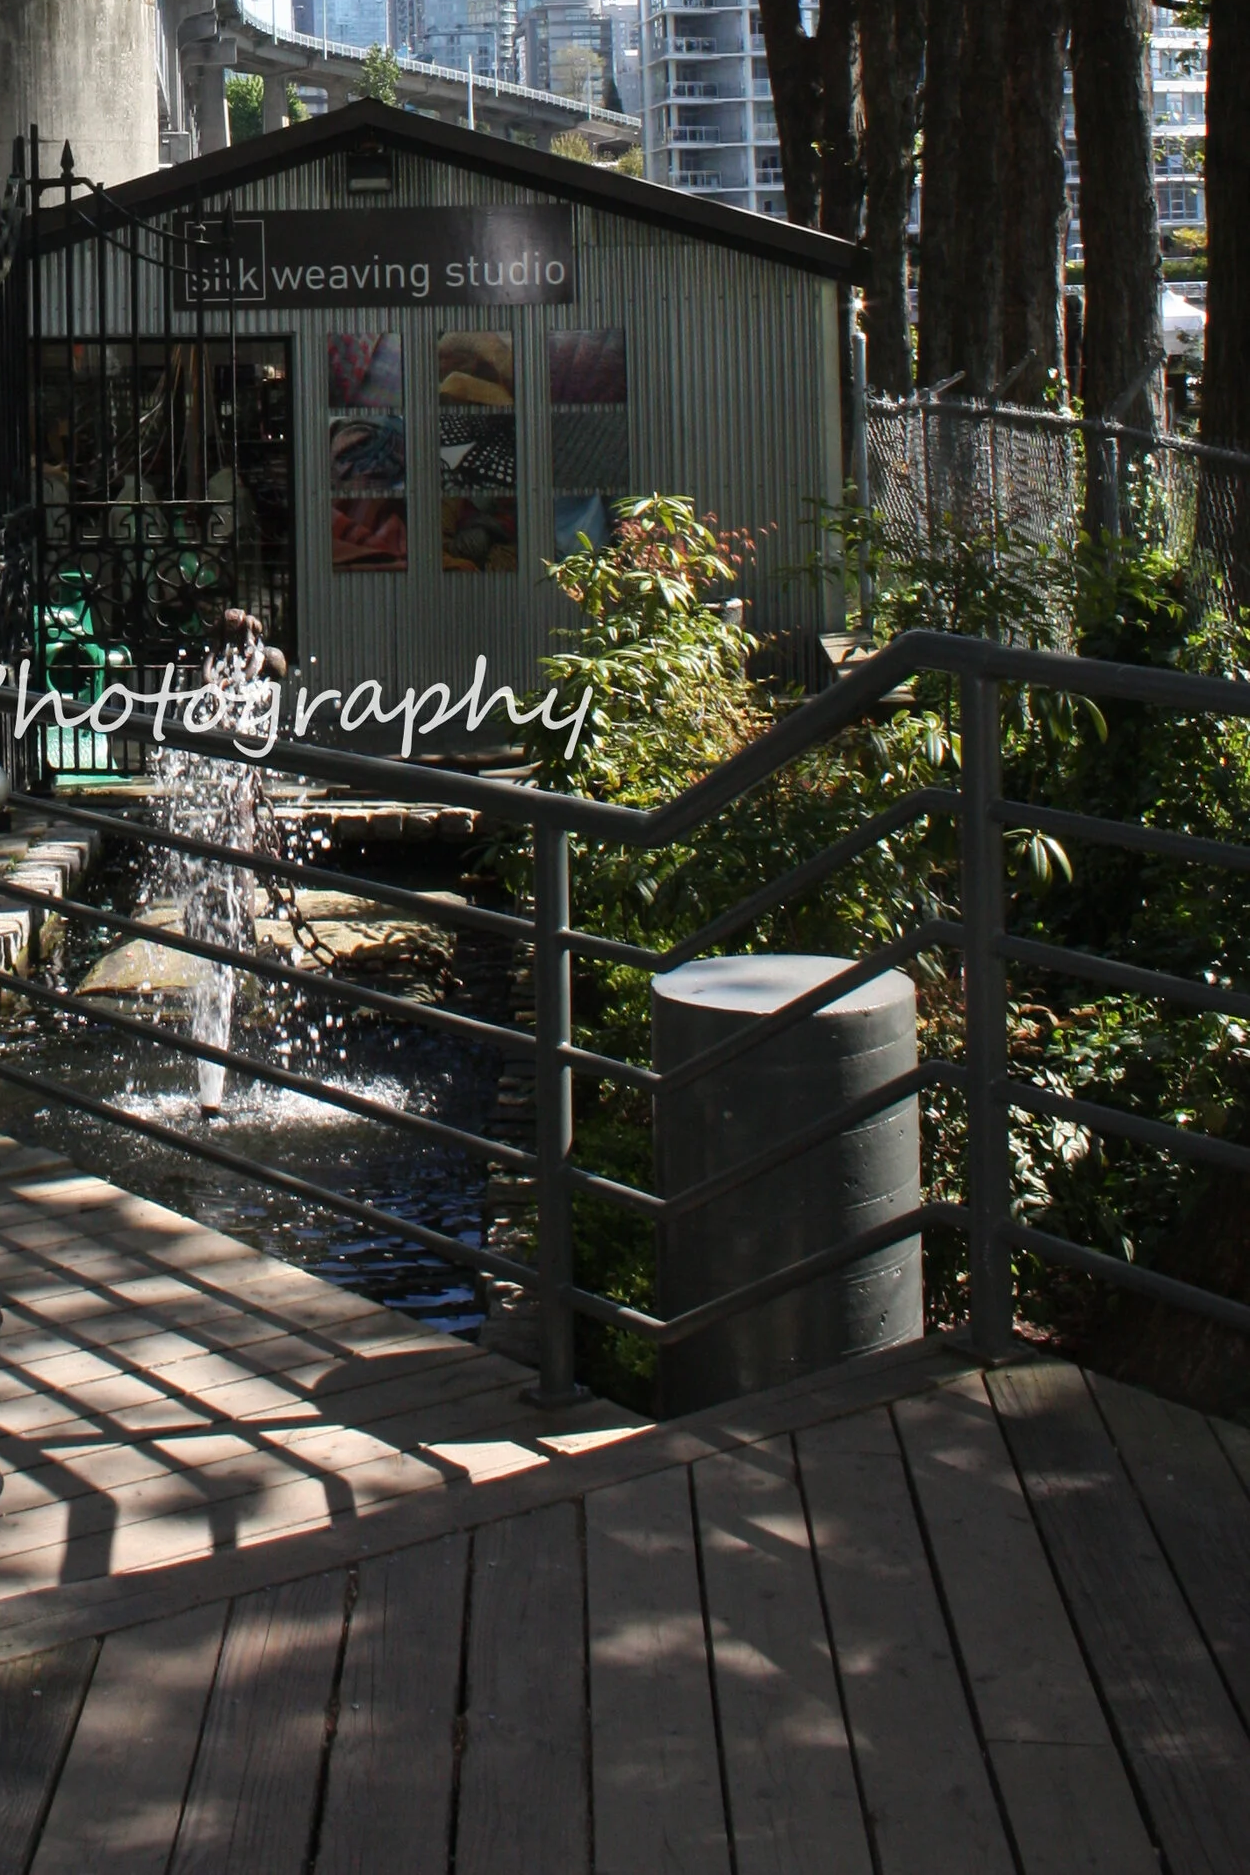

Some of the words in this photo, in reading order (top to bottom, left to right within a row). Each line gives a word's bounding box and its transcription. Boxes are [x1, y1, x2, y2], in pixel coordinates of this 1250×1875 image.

[191, 257, 260, 292] silk
[271, 254, 430, 298] weaving
[445, 251, 566, 288] studio
